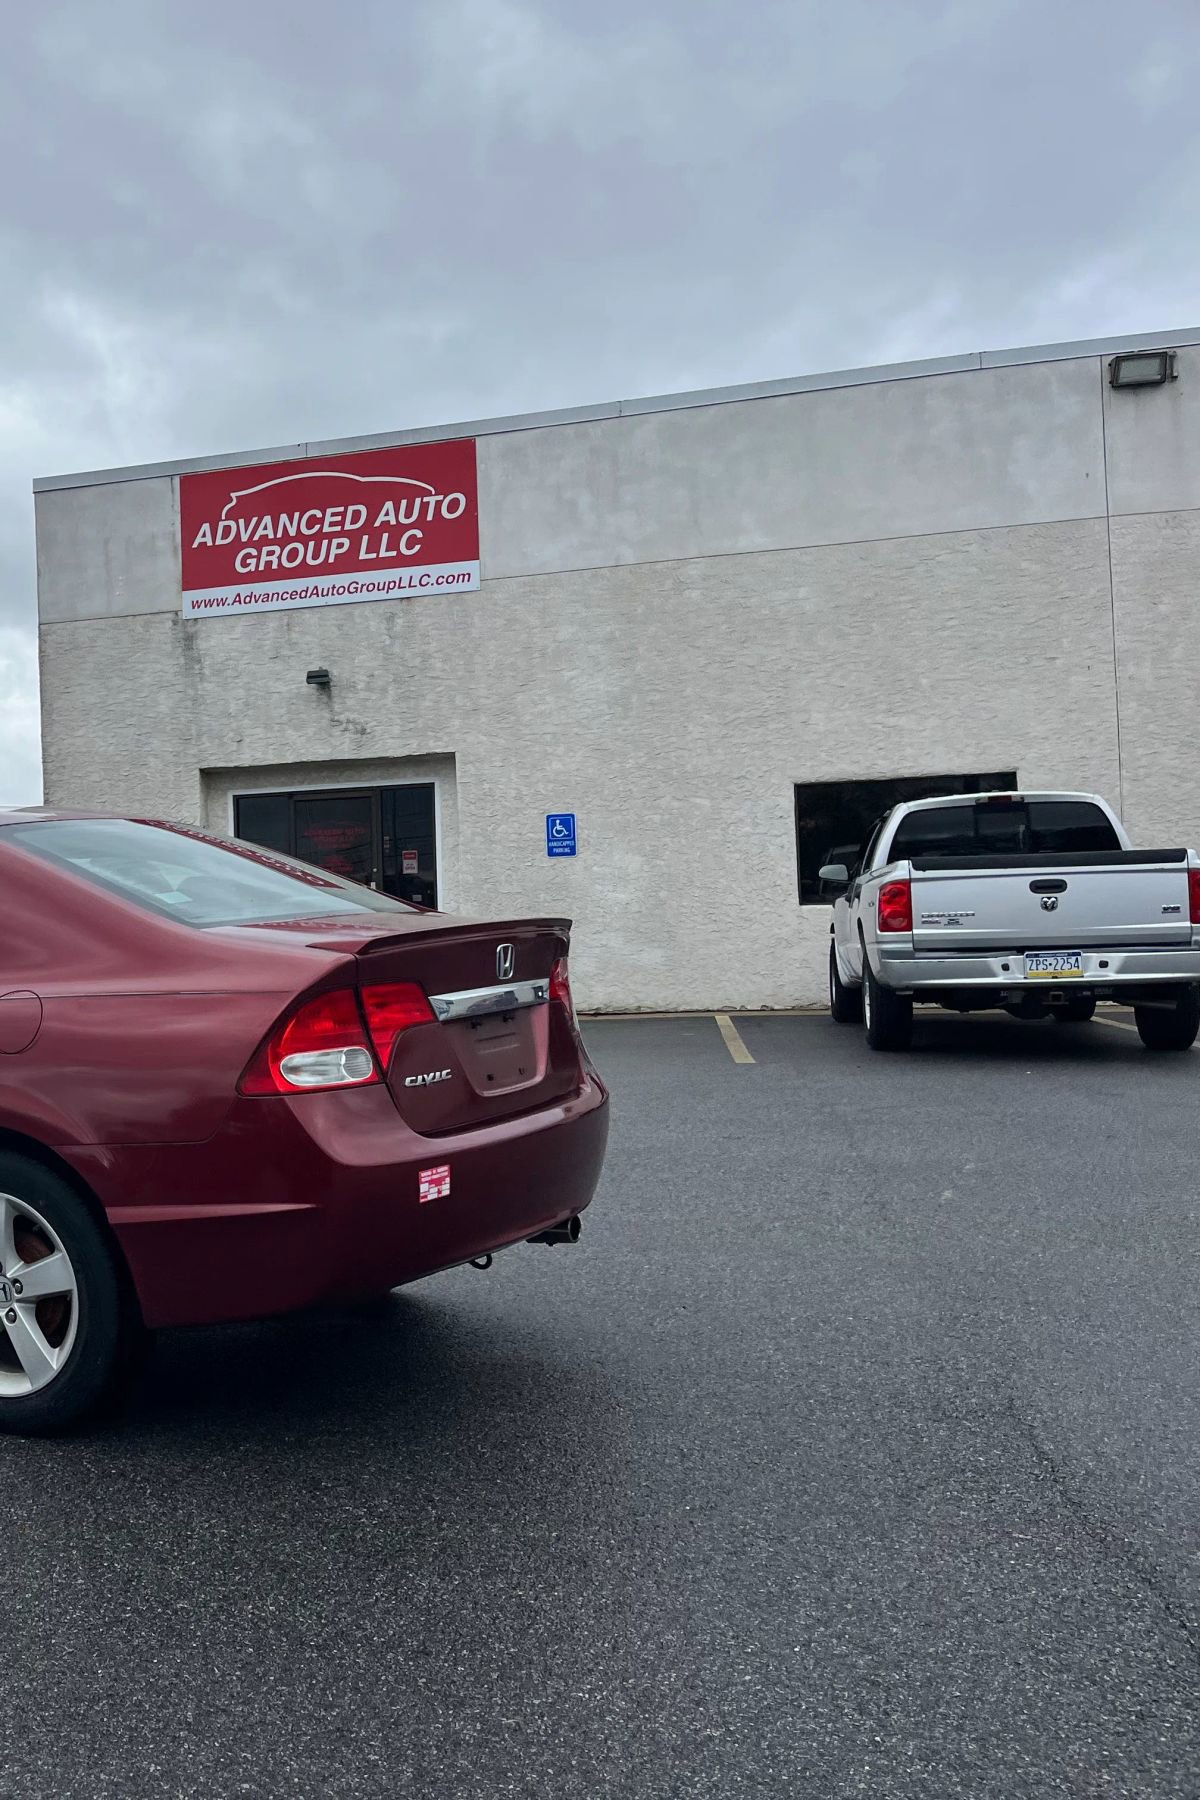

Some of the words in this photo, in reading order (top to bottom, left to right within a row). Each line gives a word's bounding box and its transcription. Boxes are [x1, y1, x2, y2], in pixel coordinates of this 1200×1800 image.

[192, 504, 367, 549] ADVANCED
[374, 492, 467, 528] AUTO
[234, 537, 350, 574] GROUP
[358, 529, 424, 561] LLC
[191, 571, 472, 610] www.AdvancedAutoGroupLLC.com
[405, 1069, 452, 1087] CIVIC
